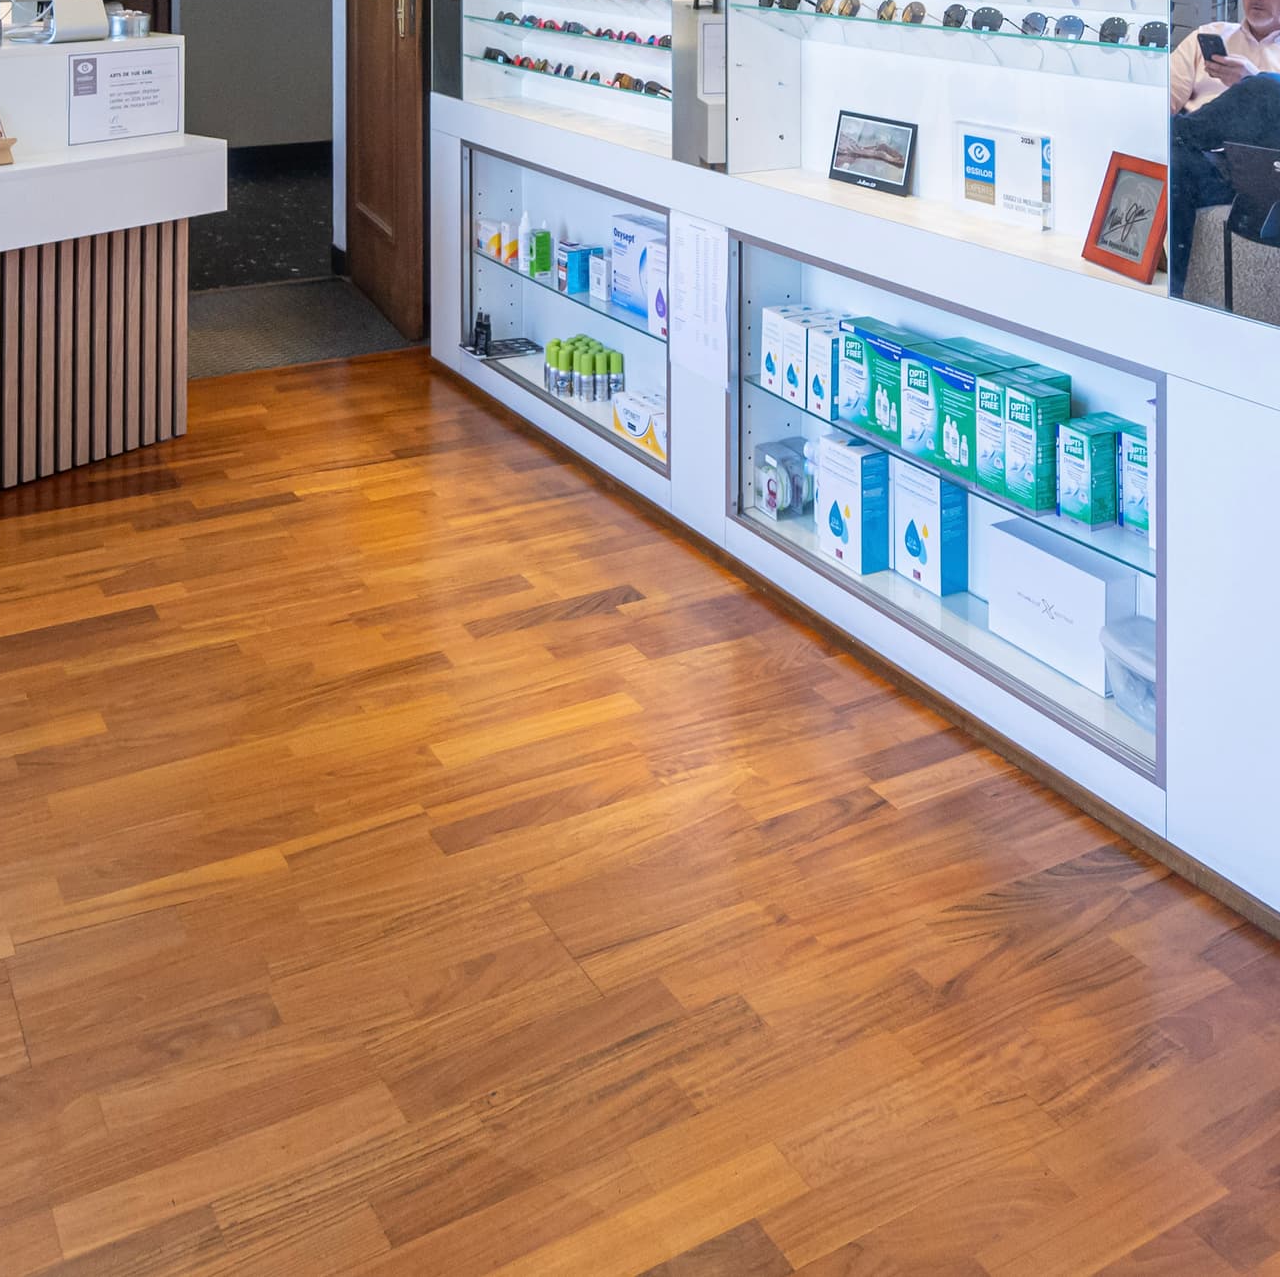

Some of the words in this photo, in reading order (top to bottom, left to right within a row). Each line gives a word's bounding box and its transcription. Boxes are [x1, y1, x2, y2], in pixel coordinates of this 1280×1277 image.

[613, 227, 635, 245] Oxysept
[846, 340, 861, 350] OPTI-
[846, 349, 861, 359] FREE
[909, 369, 927, 379] OPTI-
[909, 378, 927, 388] FREE
[980, 391, 998, 402] OPTI-
[981, 400, 999, 410] FREE
[1010, 402, 1030, 413] OPTI-
[1011, 411, 1030, 422] FREE
